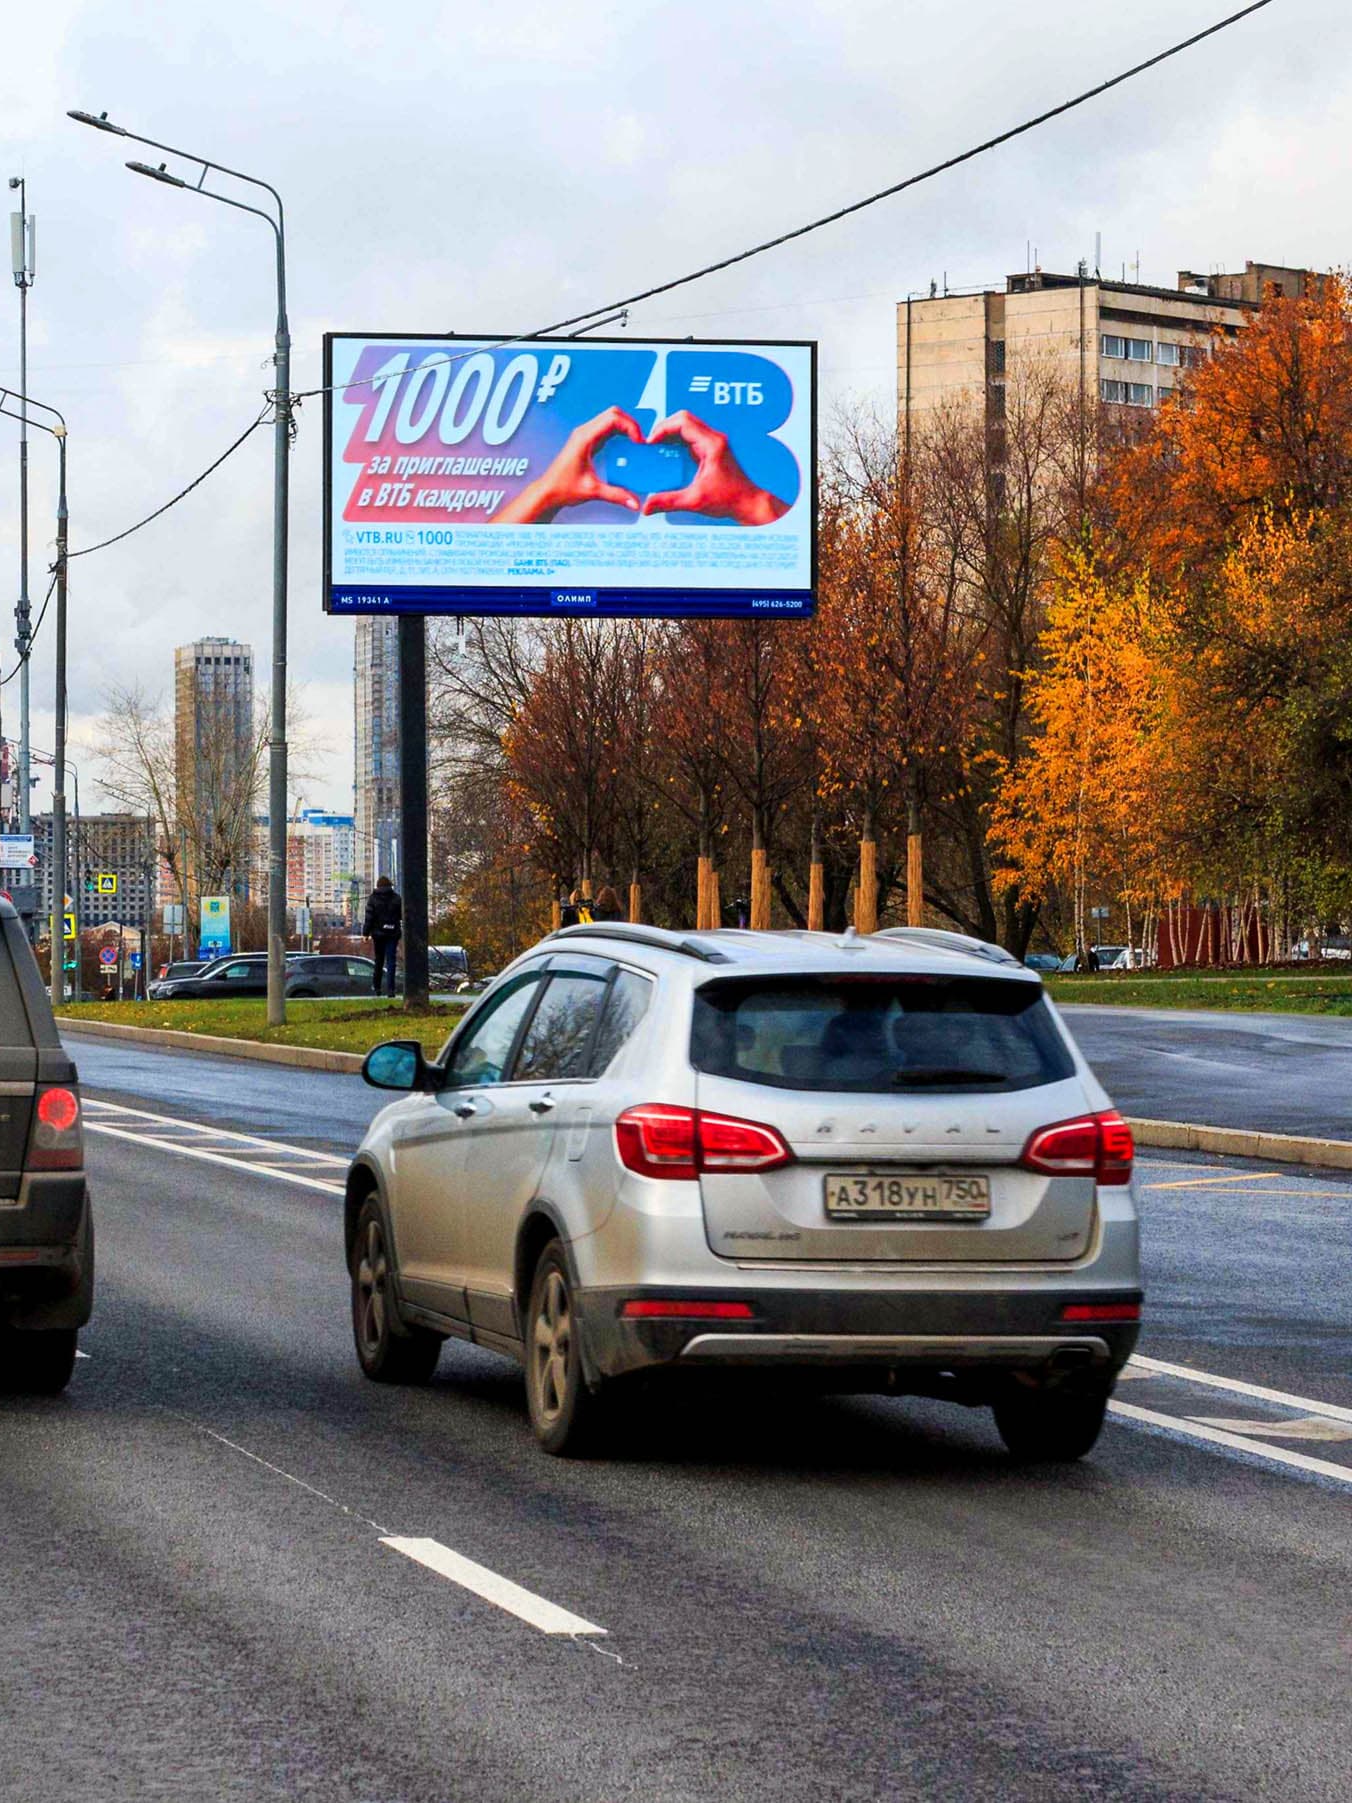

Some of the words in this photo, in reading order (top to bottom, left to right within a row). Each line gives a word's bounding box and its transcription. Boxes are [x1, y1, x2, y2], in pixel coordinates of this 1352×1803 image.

[713, 381, 764, 406] ВТБ
[367, 456, 392, 475] за
[393, 456, 529, 480] приглашение
[357, 488, 374, 506] в
[374, 483, 415, 507] ВТБ
[414, 489, 505, 514] каждому
[356, 531, 403, 544] VTB.RU
[417, 530, 453, 545] 1000
[557, 594, 592, 603] ОЛИМП
